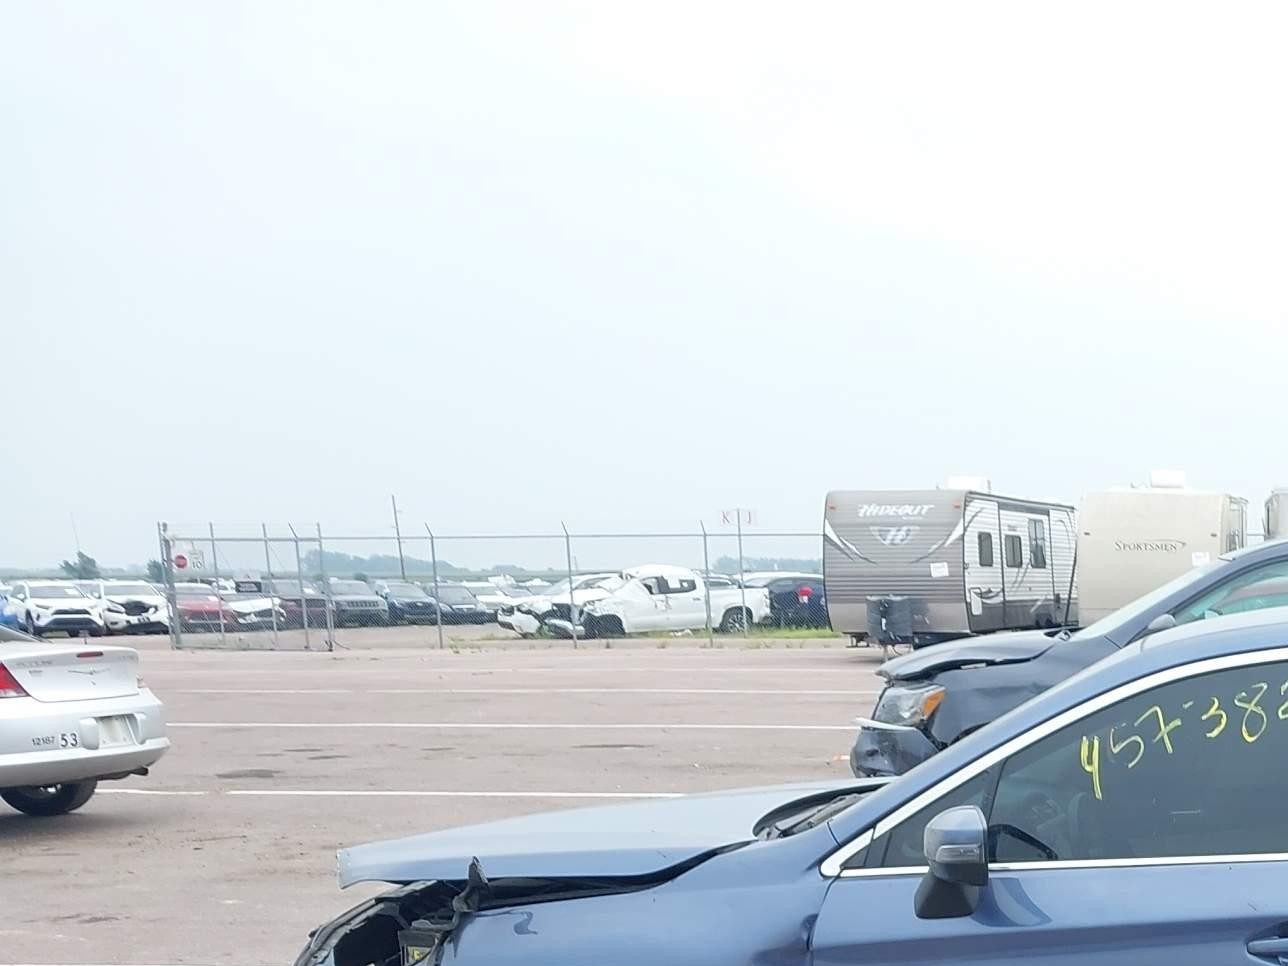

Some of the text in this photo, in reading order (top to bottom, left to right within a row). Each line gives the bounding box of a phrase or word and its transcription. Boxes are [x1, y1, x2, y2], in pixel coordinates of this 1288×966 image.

[858, 504, 935, 517] HIDEOUT
[1114, 541, 1177, 553] SPORTSMEN
[60, 732, 78, 748] 53
